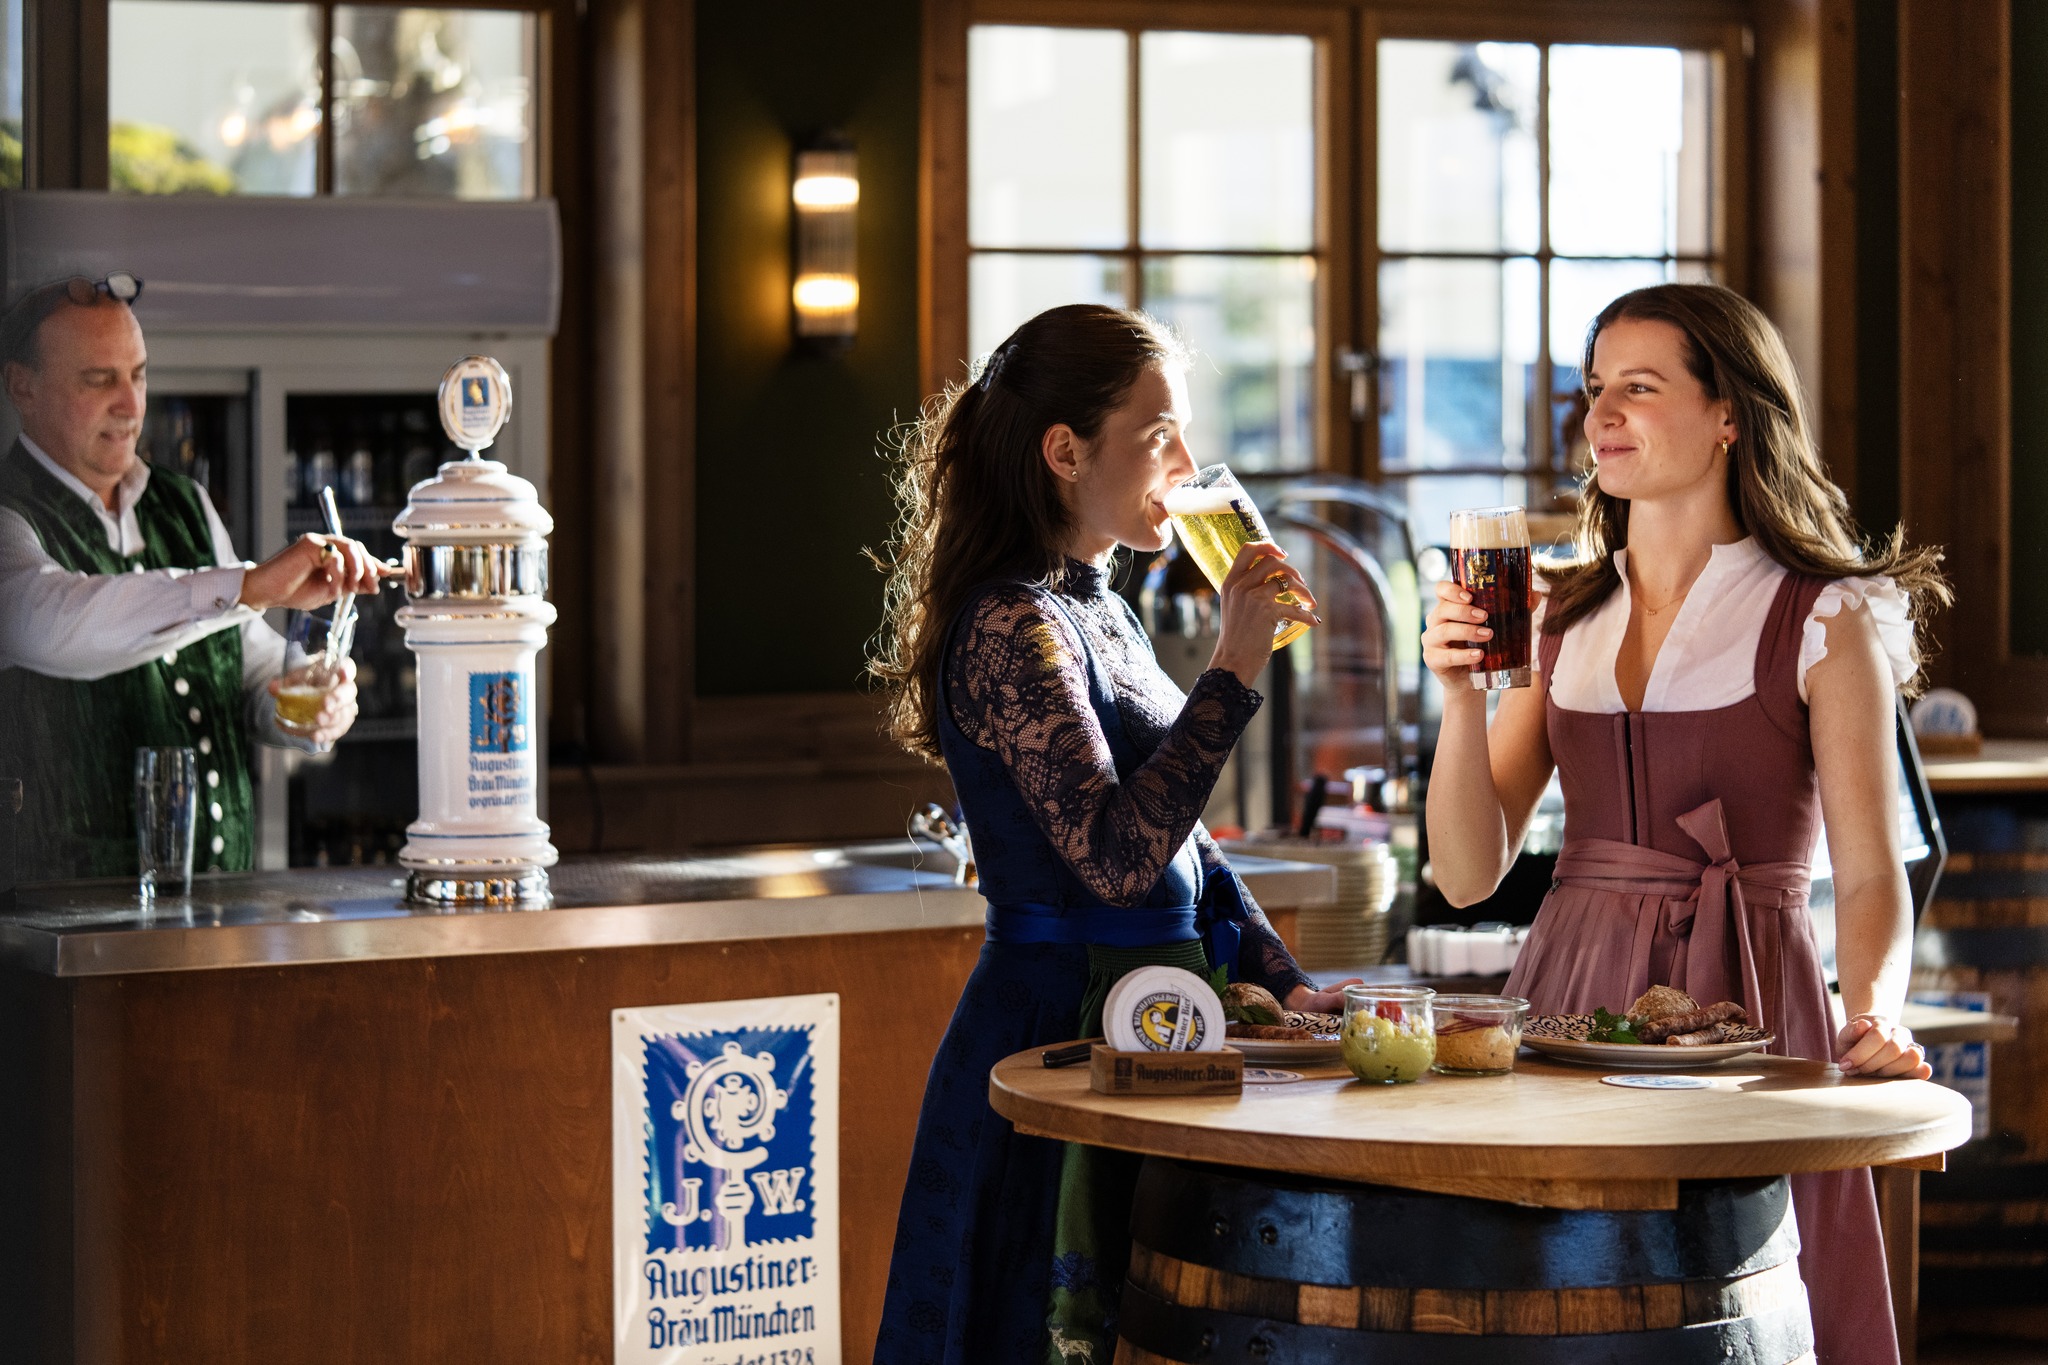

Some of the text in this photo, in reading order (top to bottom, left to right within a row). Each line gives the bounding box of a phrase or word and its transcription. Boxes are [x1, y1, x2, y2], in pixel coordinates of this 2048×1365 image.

[1172, 1017, 1189, 1051] ünchner
[647, 1300, 816, 1349] Bräu München
